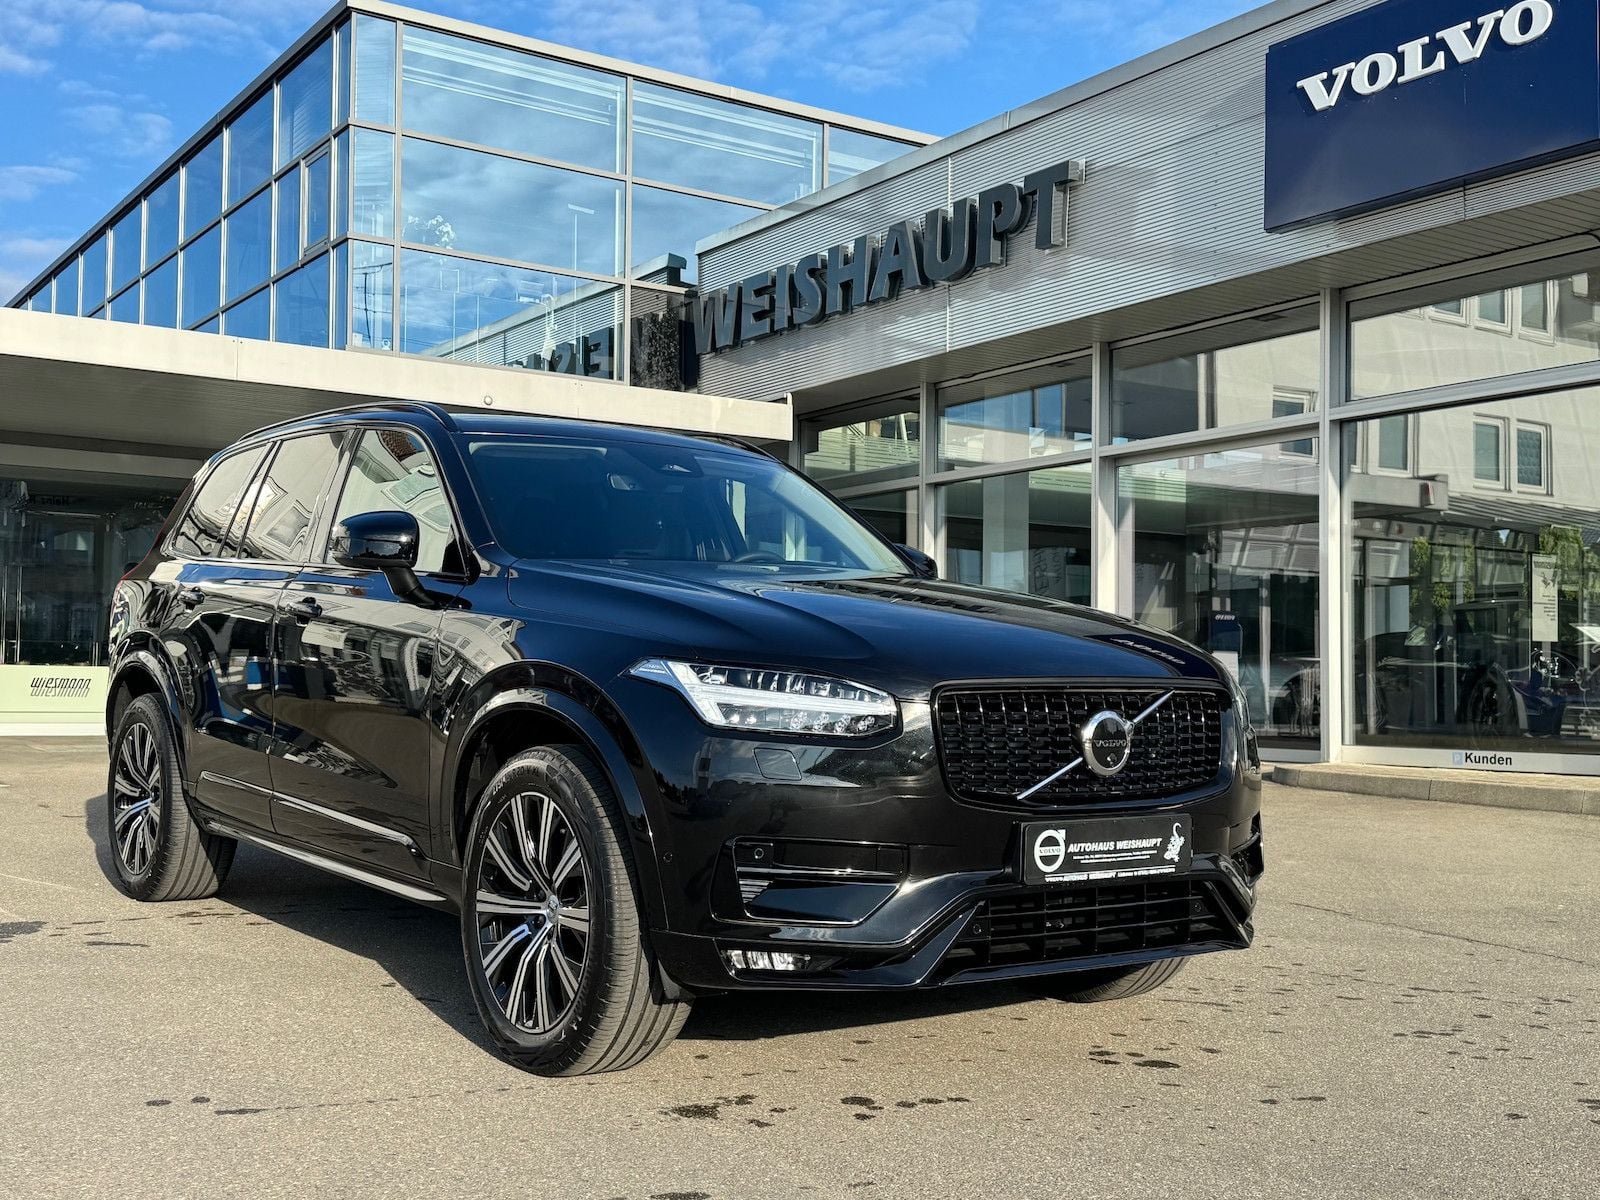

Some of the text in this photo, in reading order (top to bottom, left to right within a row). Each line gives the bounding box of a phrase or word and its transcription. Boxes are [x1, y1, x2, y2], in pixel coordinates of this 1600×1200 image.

[1296, 0, 1553, 111] VOLVO
[692, 160, 1078, 355] WEISHAUPT
[1093, 739, 1127, 747] VOLVO
[1465, 752, 1512, 766] Kunden
[1067, 838, 1162, 853] AUTOHAUS WEISHAUPT
